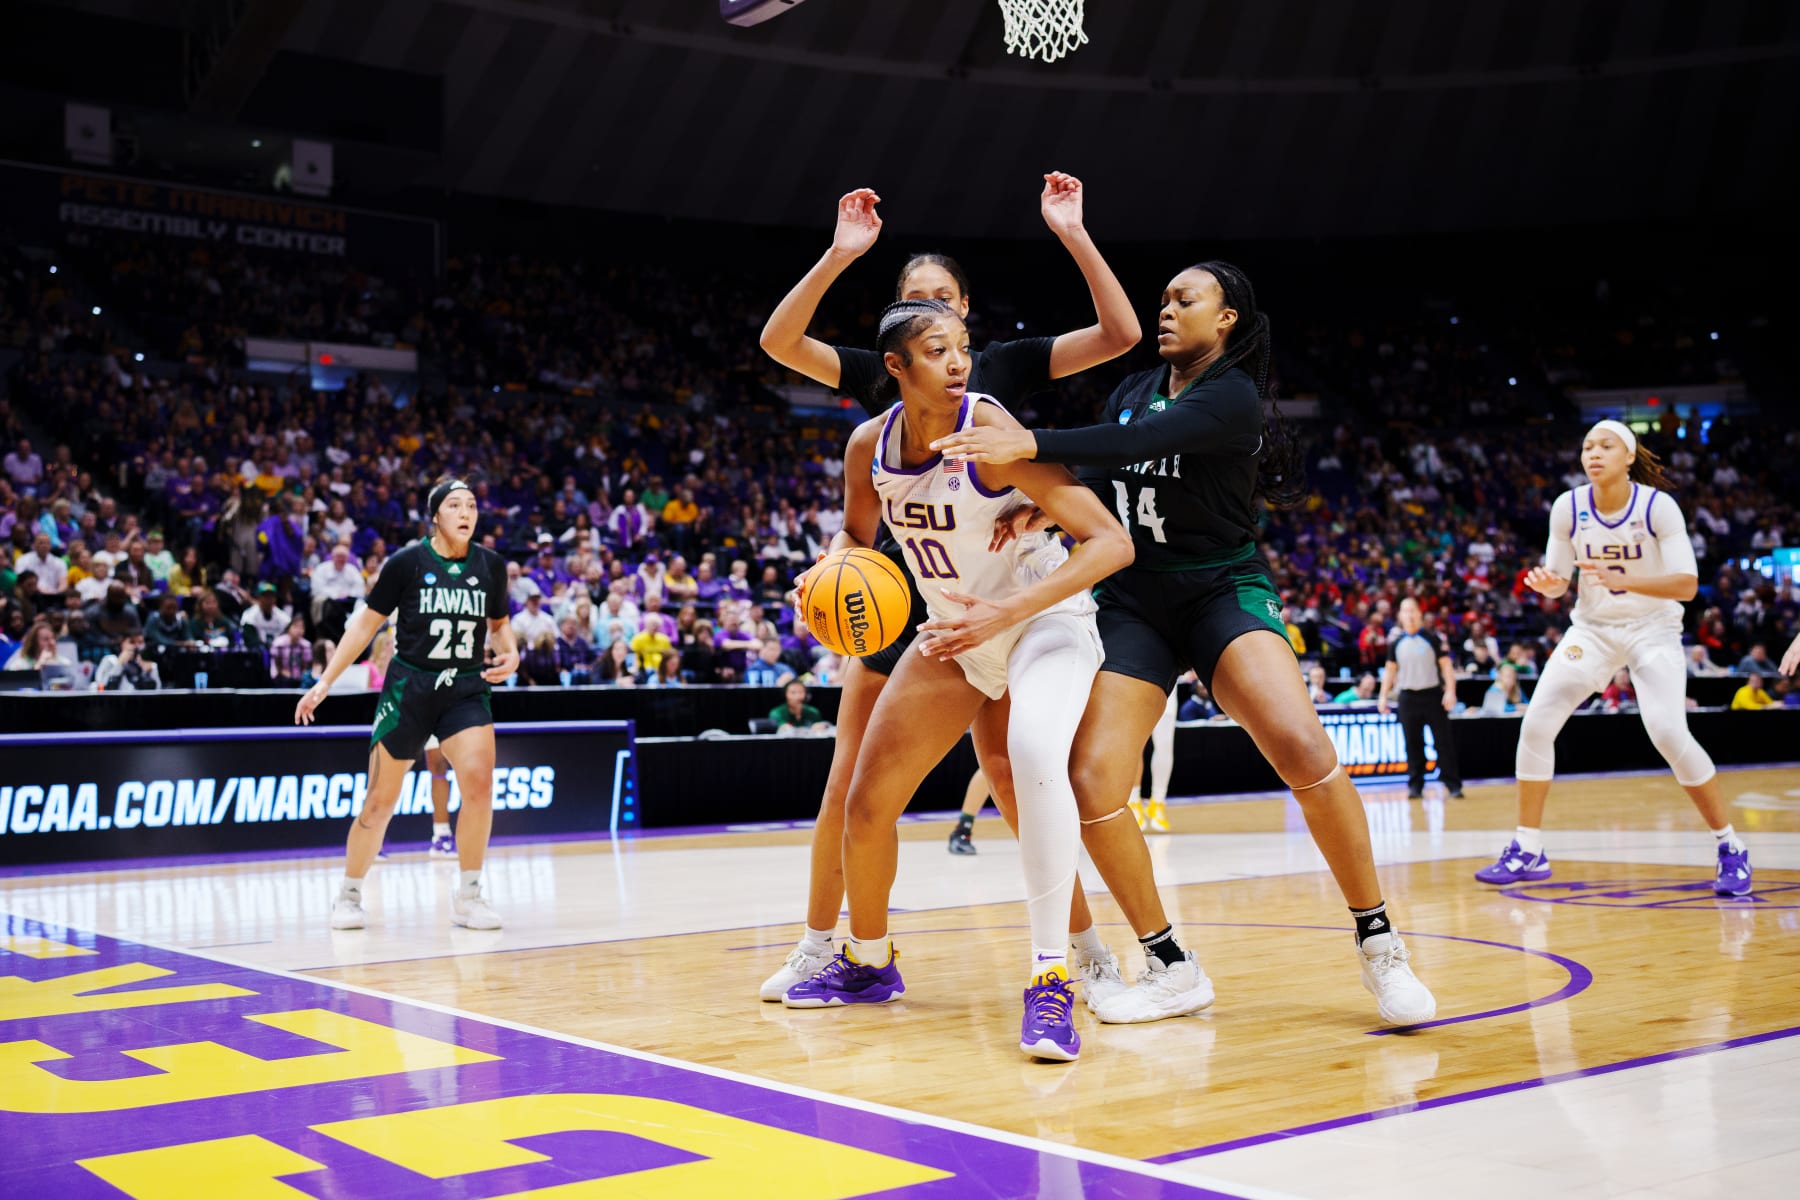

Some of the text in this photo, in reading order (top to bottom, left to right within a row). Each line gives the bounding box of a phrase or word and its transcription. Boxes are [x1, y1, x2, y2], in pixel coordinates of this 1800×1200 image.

[60, 174, 347, 233] PETE MARAVICH
[58, 201, 228, 242] ASSEMBLY
[235, 222, 347, 256] CENTER
[886, 497, 956, 532] LSU
[1111, 479, 1168, 543] 14
[904, 537, 960, 580] 10
[1585, 543, 1643, 561] LSU
[427, 618, 478, 660] 23
[843, 589, 870, 654] Wilson
